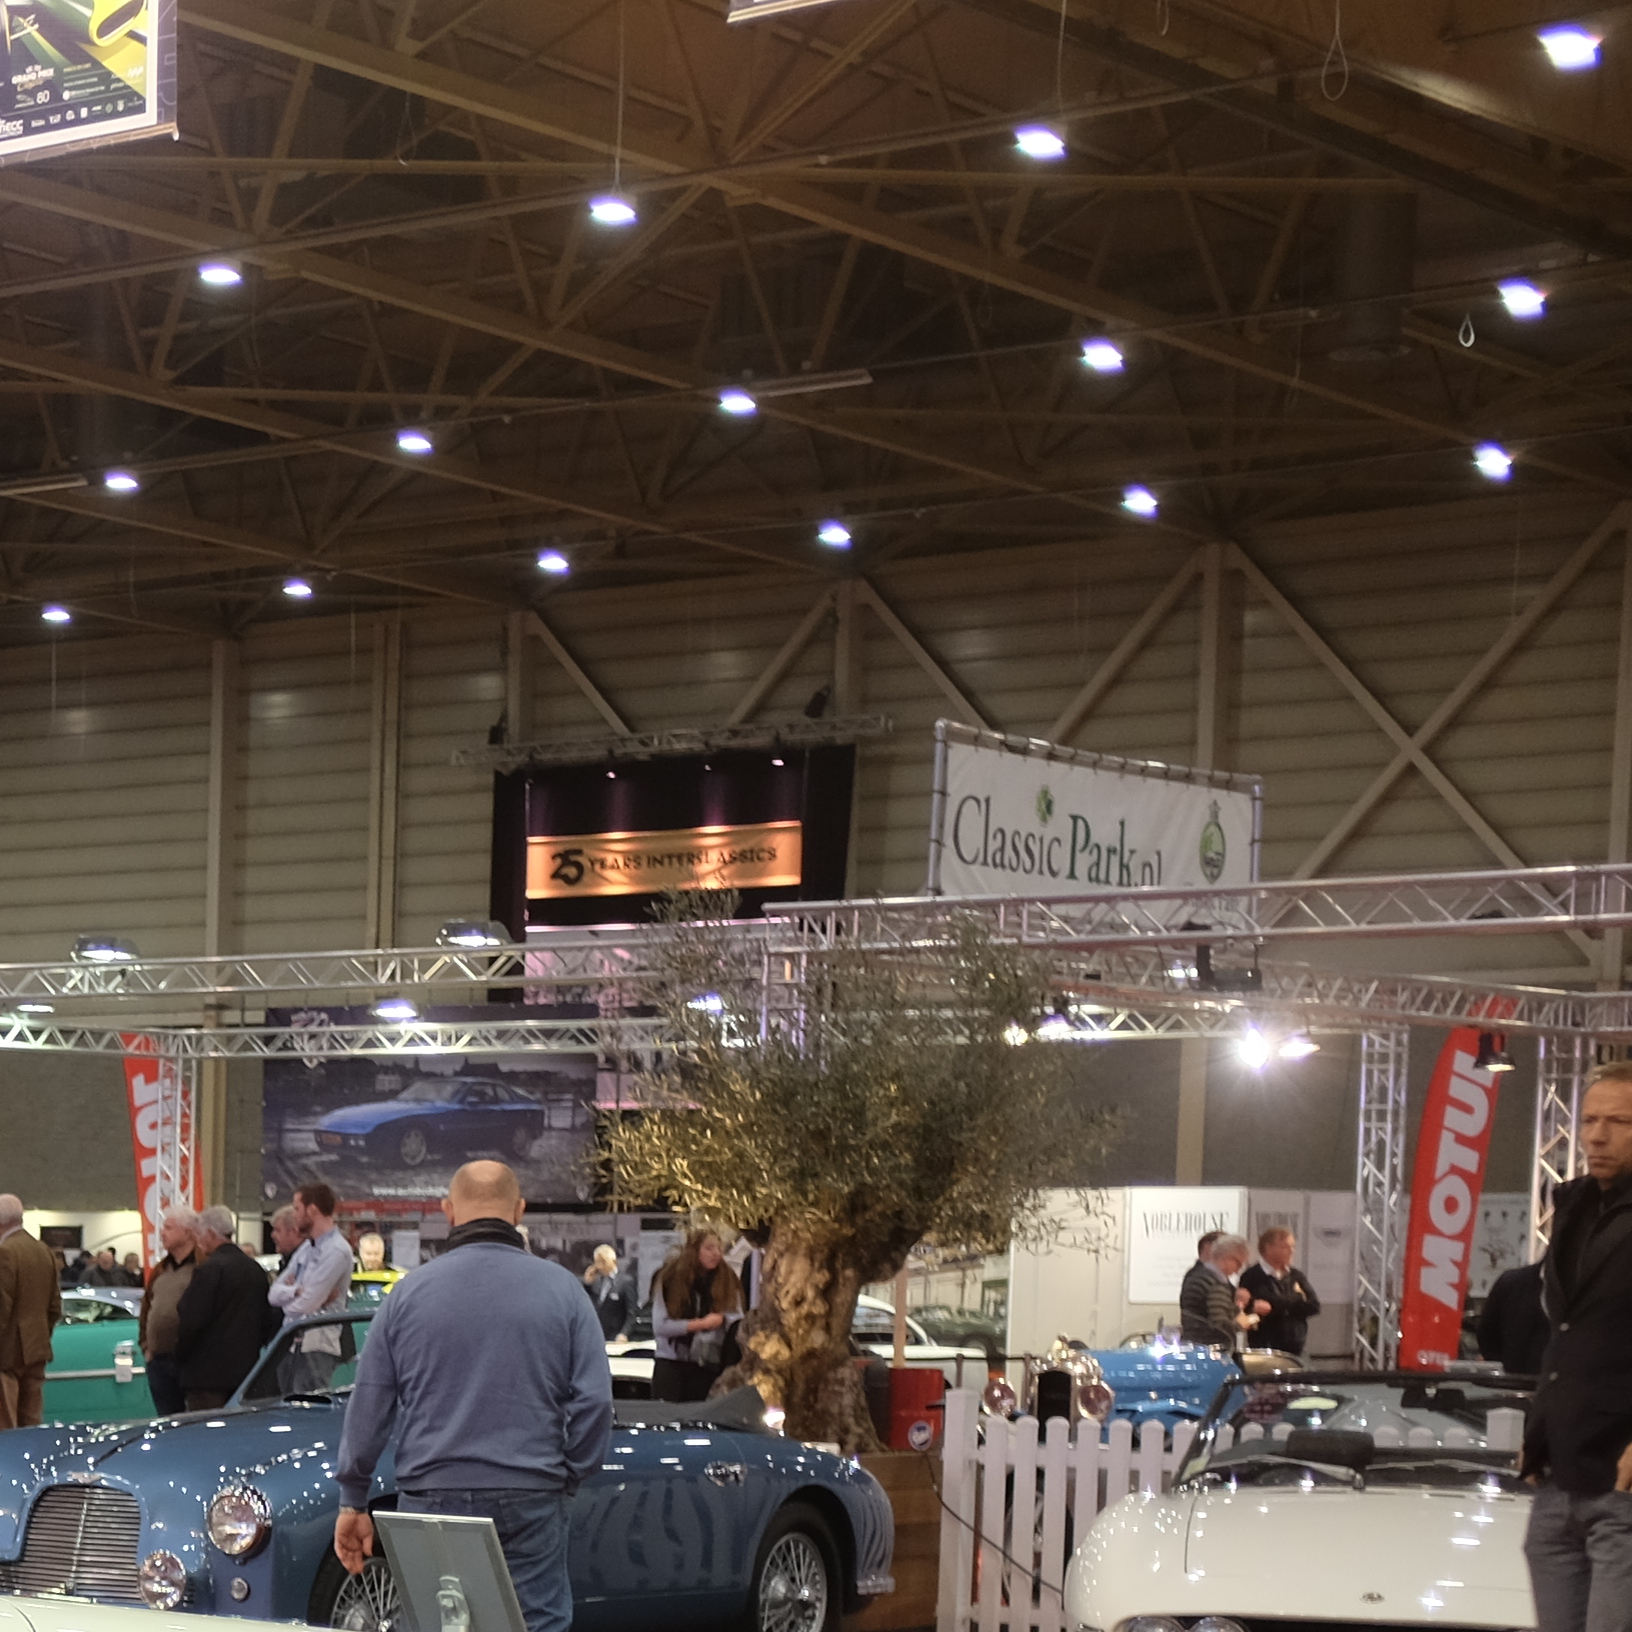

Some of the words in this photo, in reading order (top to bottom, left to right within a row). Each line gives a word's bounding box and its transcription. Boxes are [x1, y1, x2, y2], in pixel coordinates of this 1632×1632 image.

[551, 849, 584, 886] 25
[588, 855, 643, 871] YEARS
[1420, 1049, 1494, 1311] MOTUL
